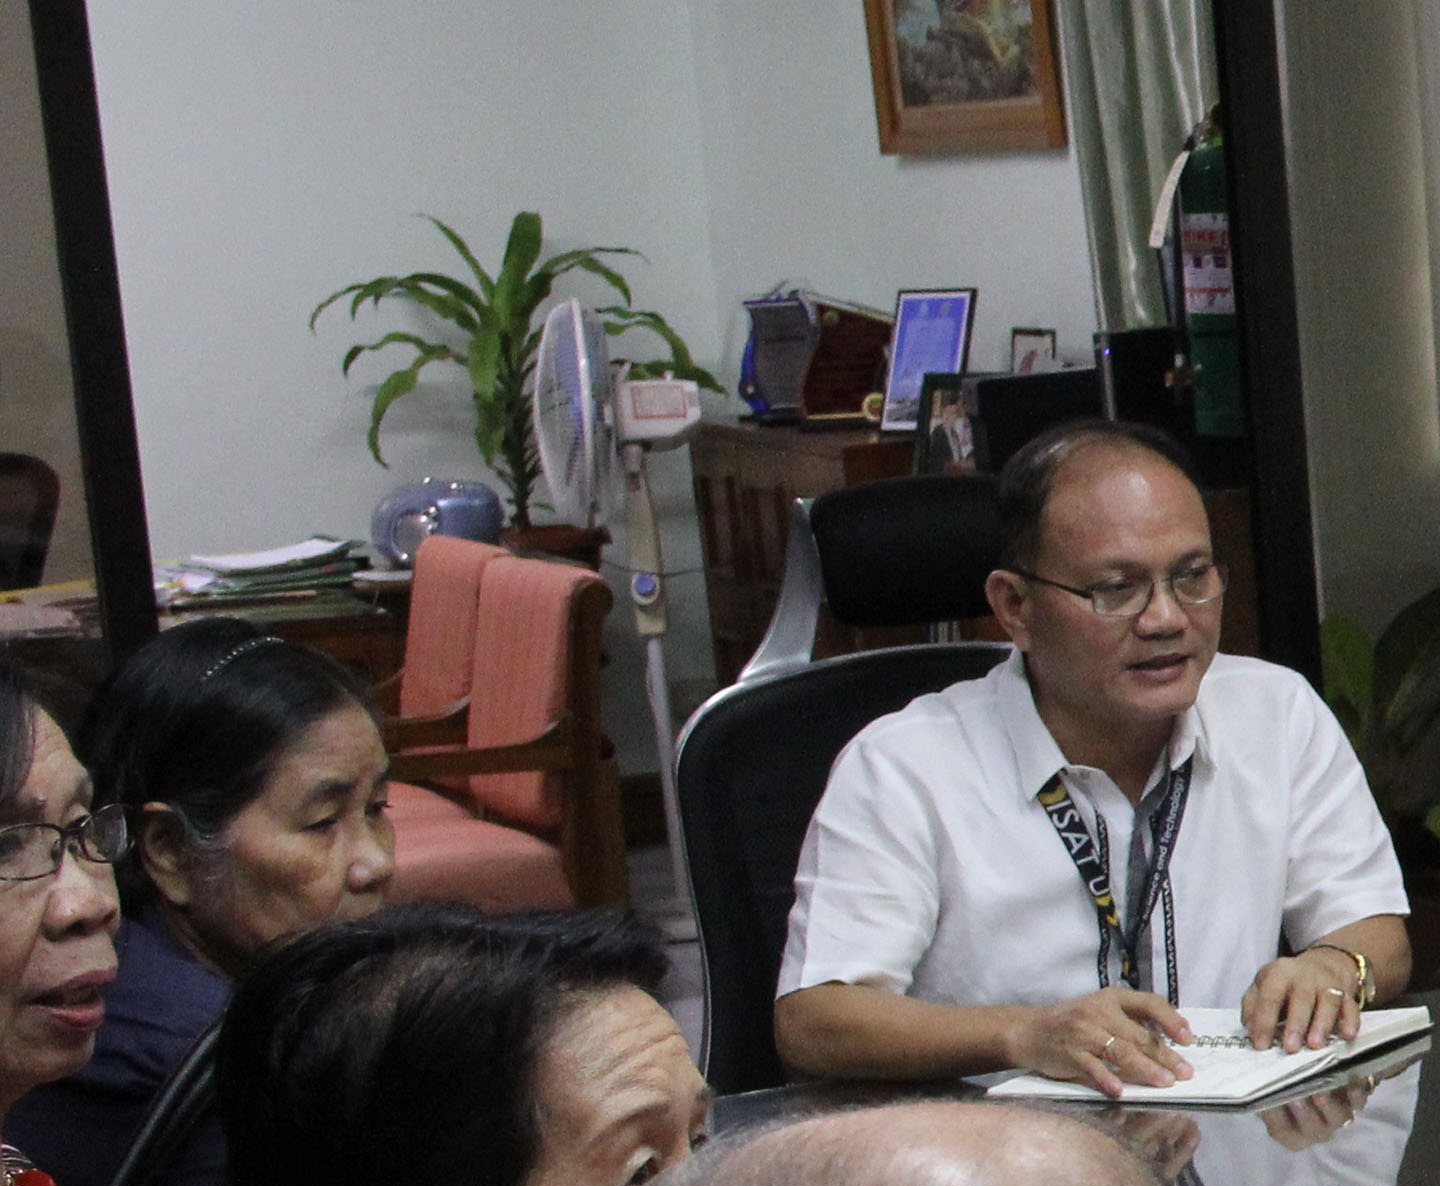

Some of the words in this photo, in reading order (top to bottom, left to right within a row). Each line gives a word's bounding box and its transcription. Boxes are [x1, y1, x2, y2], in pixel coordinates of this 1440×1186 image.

[1161, 777, 1185, 844] Technology
[1046, 799, 1100, 866] ISAT
[1089, 875, 1111, 897] U
[1156, 846, 1168, 870] and
